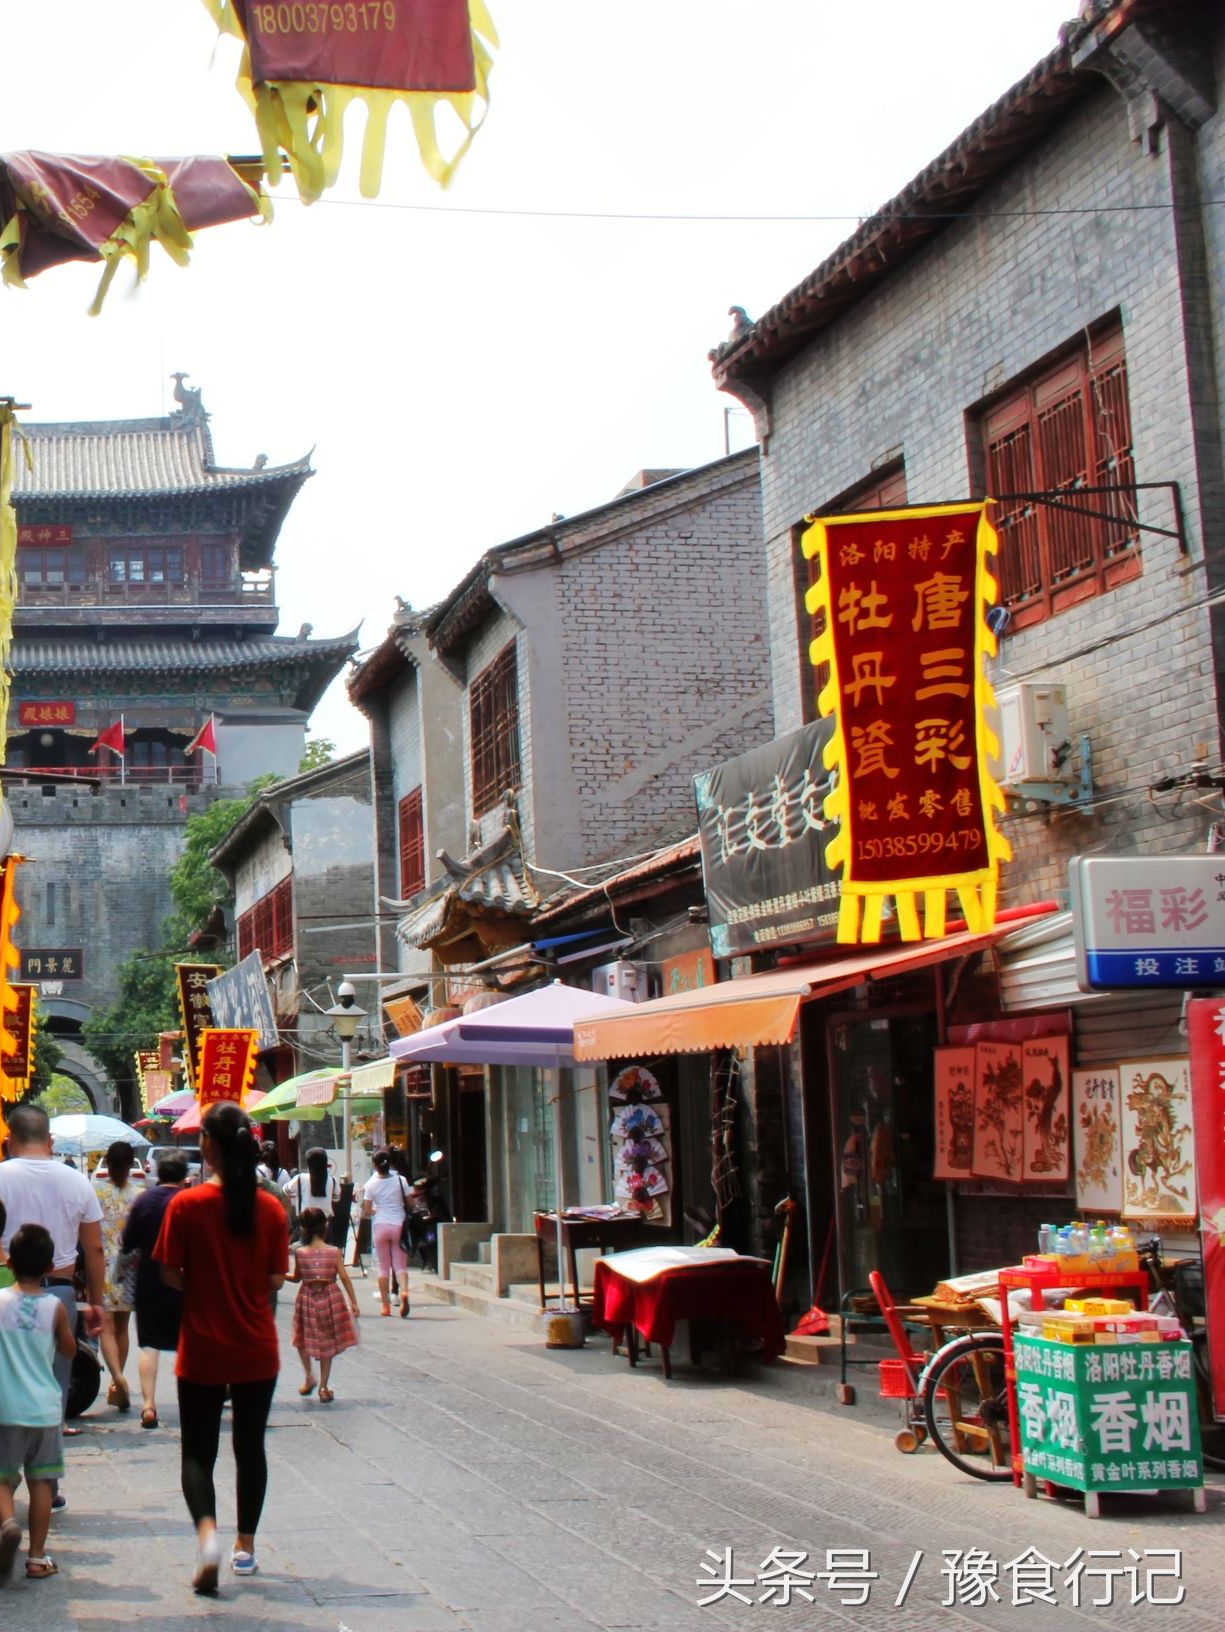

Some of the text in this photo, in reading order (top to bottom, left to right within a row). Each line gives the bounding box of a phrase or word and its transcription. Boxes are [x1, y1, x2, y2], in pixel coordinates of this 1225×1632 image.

[254, 3, 396, 33] 18003793179
[839, 529, 966, 567] 洛阳特产
[837, 581, 901, 780] 牡丹瓷
[911, 572, 972, 774] 唐三彩
[858, 788, 975, 821] 批发零售
[857, 828, 982, 860] 15038599479
[1105, 887, 1209, 935] 福彩
[1015, 1342, 1076, 1382] 洛阳牡丹香烟
[1085, 1350, 1192, 1383] 洛阳牡丹香烟
[1018, 1381, 1081, 1454] 香烟
[1090, 1390, 1192, 1454] 香烟
[1091, 1459, 1199, 1483] 黄金叶系列香烟
